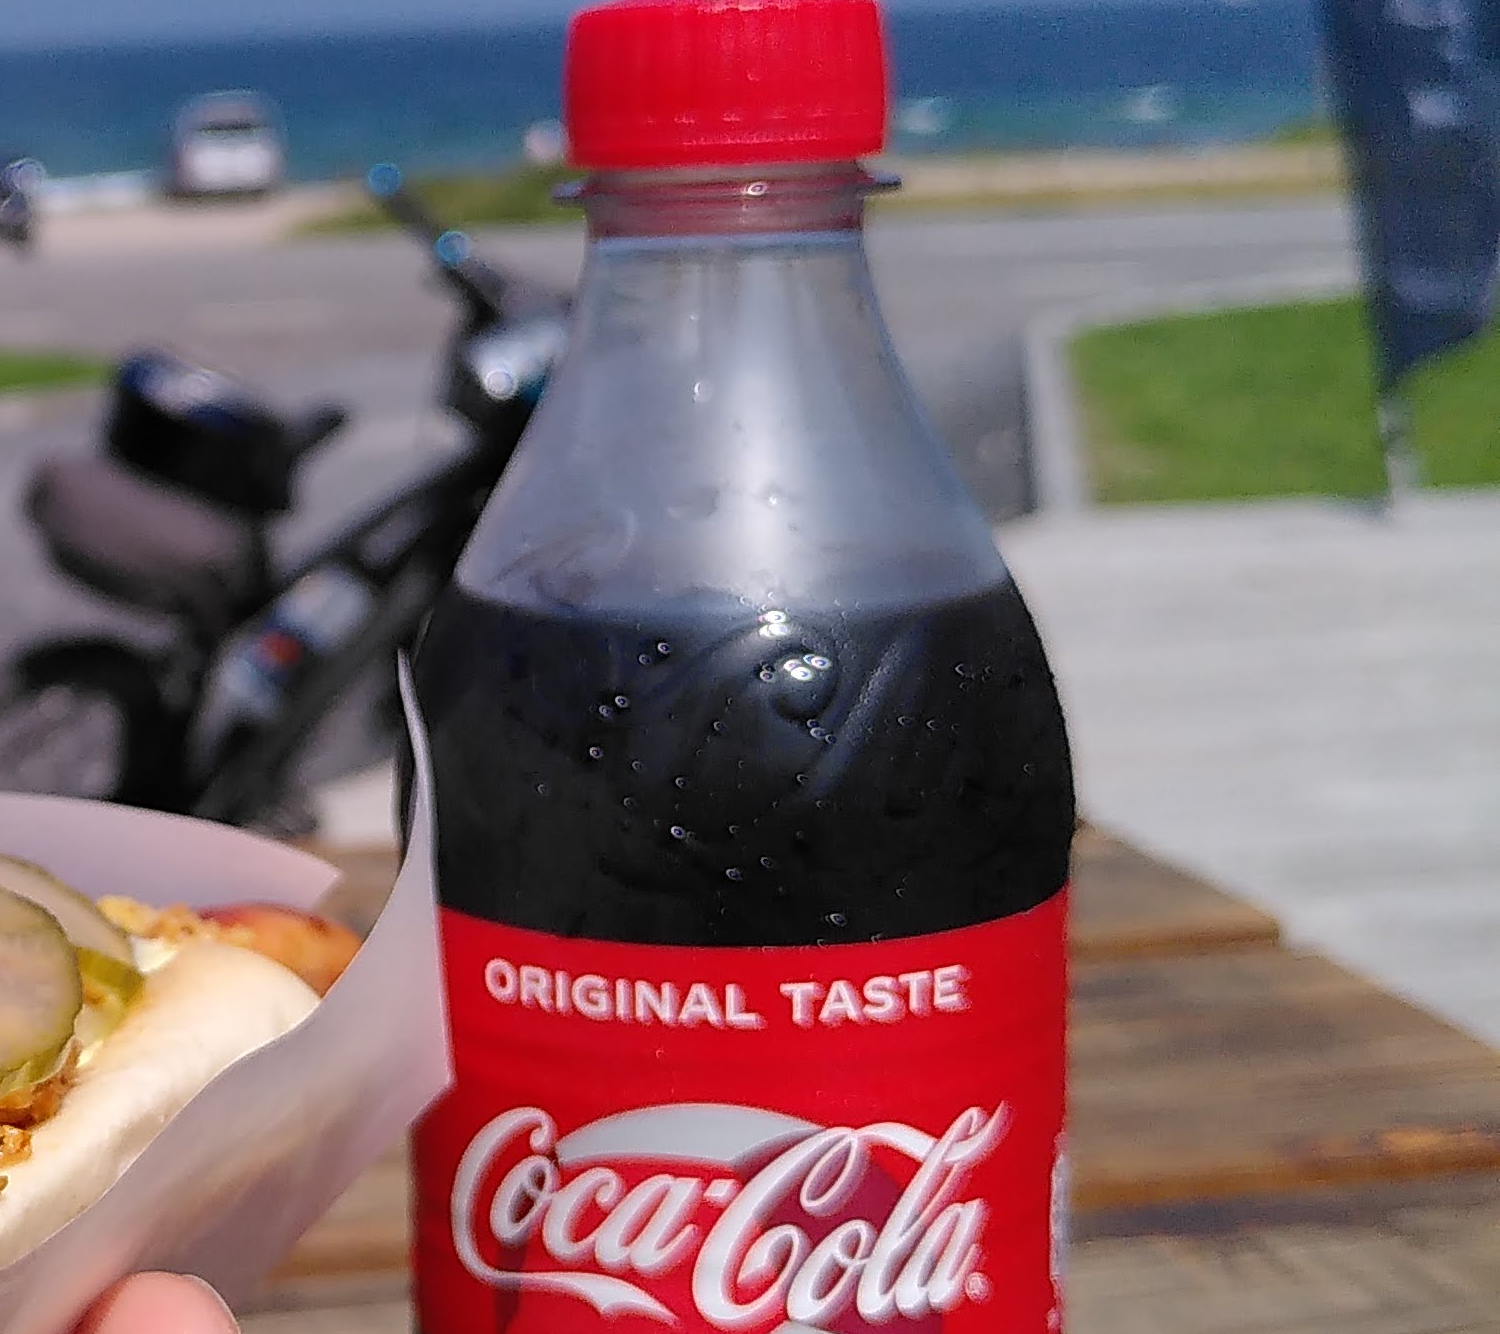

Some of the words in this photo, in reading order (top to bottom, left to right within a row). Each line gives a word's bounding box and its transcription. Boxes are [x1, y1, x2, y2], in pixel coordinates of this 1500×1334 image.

[484, 958, 765, 1029] ORIGINAL
[779, 965, 971, 1028] TASTE
[451, 1100, 1010, 1330] Coca-Cola
